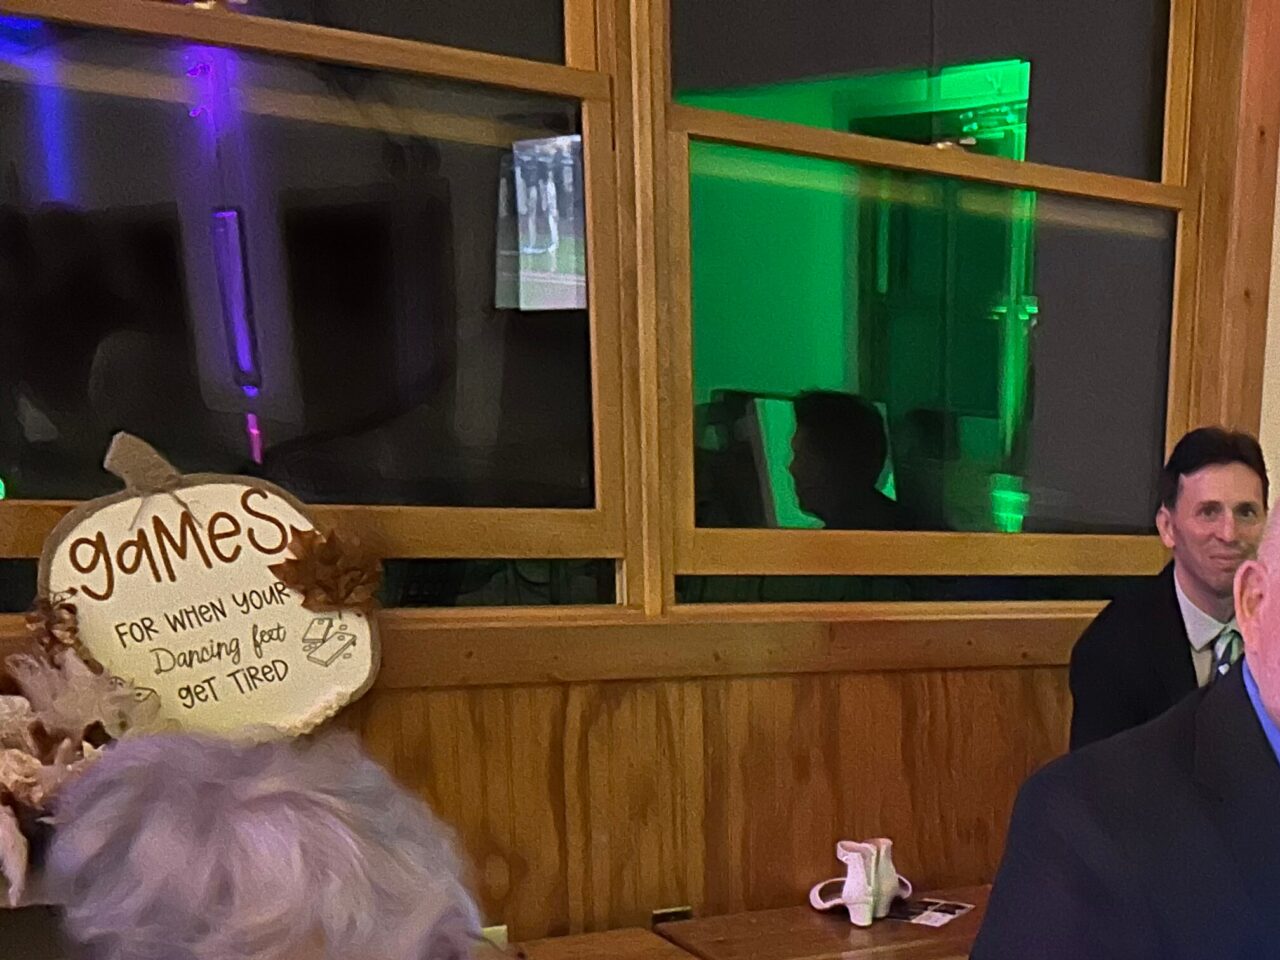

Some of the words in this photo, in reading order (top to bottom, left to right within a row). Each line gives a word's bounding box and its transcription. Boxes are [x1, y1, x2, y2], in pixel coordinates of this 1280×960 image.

[114, 615, 159, 648] FOR
[150, 638, 241, 676] Dancing
[252, 622, 288, 659] feet
